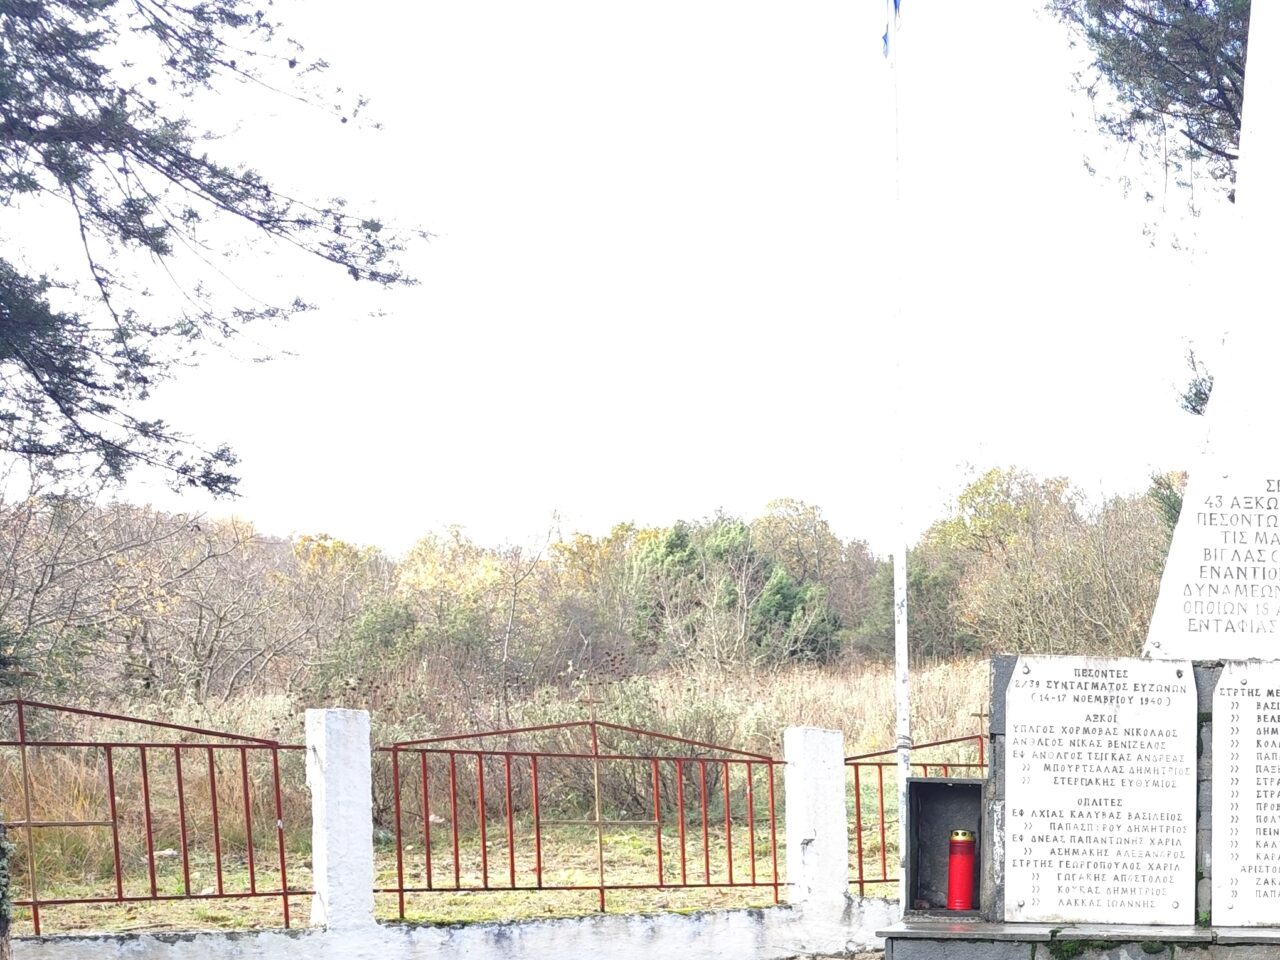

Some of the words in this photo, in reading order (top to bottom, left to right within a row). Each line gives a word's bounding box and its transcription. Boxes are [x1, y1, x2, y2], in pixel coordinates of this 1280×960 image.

[1204, 496, 1222, 508] 43
[1222, 530, 1248, 544] ΤΙΣ
[1204, 548, 1266, 562] ΒΙΓΛΑΣ
[1184, 600, 1246, 614] ΟΠΟΙΩΝ
[1074, 668, 1128, 680] ΠΕΣΟΝΤΕΣ
[1014, 680, 1040, 688] 2/39
[1046, 680, 1128, 692] ΣΥΝΤΑΓΜΑΤΟΣ
[1134, 683, 1186, 694] ΕΥΖΩΝΩΝ
[1220, 688, 1260, 698] ΣΤΡΤΗΣ
[1072, 694, 1134, 706] ΝΟΕΜΒΡΙΟΥ
[1140, 696, 1170, 706] 1940)
[1086, 714, 1118, 724] ΑΞΚΟΙ
[1014, 724, 1054, 734] ΥΠΛΓΟΣ
[1062, 726, 1118, 736] ΧΟΡΜΟΒΑΣ
[1124, 728, 1178, 738] ΝΙΚΟΛΑΟΣ
[1070, 738, 1102, 748] ΝΙΚΑΣ
[1108, 740, 1166, 750] ΒΕΝΙΖΕΛΟΣ
[1032, 752, 1082, 760] ΑΝΘΛΓΟΣ
[1088, 752, 1132, 762] ΤΣΙΓΚΑΣ
[1136, 754, 1184, 762] ΑΝΔΡΕΑΣ
[1044, 764, 1124, 774] ΜΠΟΥΡΤΣΑΛΑΣ
[1120, 778, 1176, 788] ΕΥΘΥΜΙΟΣ
[1078, 798, 1122, 806] ΟΠΛΙΤΕΣ
[1012, 808, 1024, 816] ΕΦ
[1030, 810, 1064, 818] ΛΧΙΑΣ
[1070, 810, 1122, 820] ΚΑΛΥΒΑΣ
[1128, 812, 1182, 822] ΒΑΣΙΛΕΙΟΣ
[1126, 824, 1186, 834] ΔΗΜΗΤΡΙΟΣ
[1012, 834, 1024, 842] ΕΦ
[1030, 834, 1066, 844] ΔΝΕΑΣ
[1070, 836, 1142, 844] ΠΑΠΑΝΤΩΝΗΣ
[1150, 838, 1182, 846] ΧΑΡΙΛ
[1050, 848, 1108, 856] ΑΣΗΜΑΚΗΣ
[1116, 850, 1184, 858] ΑΛΕΞΑΝΔΡΟΣ
[1012, 858, 1052, 868] ΣΤΡΤΗΣ
[1058, 860, 1140, 870] ΓΕΩΡΓΟΠΟΥΛΟΣ
[1148, 862, 1180, 872] ΧΑΡΙΛ
[1058, 872, 1106, 882] ΓΩΓΑΚΗΣ
[1112, 874, 1173, 884] ΑΠΟΣΤΟΛΟΣ
[1106, 886, 1165, 896] ΔΗΜΗΤΡΙΟΣ
[1058, 898, 1100, 906] ΛΑΚΚΑΣ
[1108, 900, 1154, 908] ΙΩΑΝΝΗΣ
